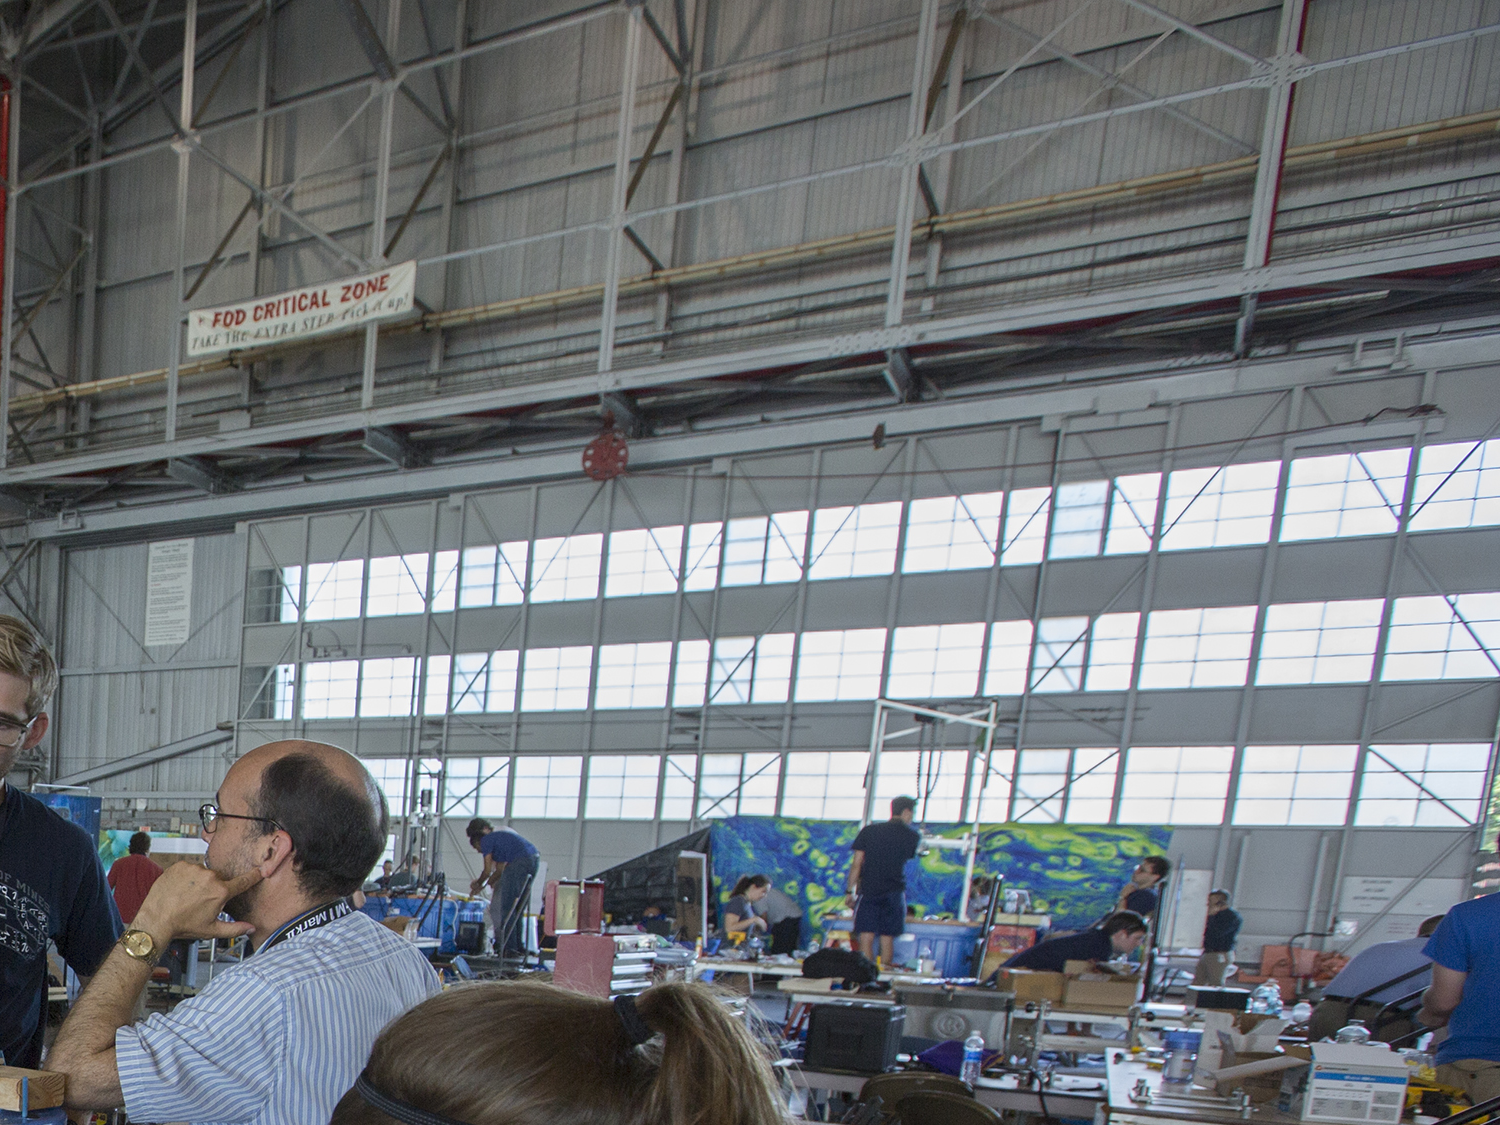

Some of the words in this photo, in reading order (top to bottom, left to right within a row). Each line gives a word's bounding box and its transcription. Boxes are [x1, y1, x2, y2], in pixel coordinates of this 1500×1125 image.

[212, 309, 247, 327] FOD
[253, 290, 331, 322] CRITICAL
[340, 274, 390, 303] ZONE
[192, 331, 219, 349] TAKE
[225, 329, 249, 344] THE
[254, 321, 296, 339] EXTRA
[301, 313, 334, 332] STEP
